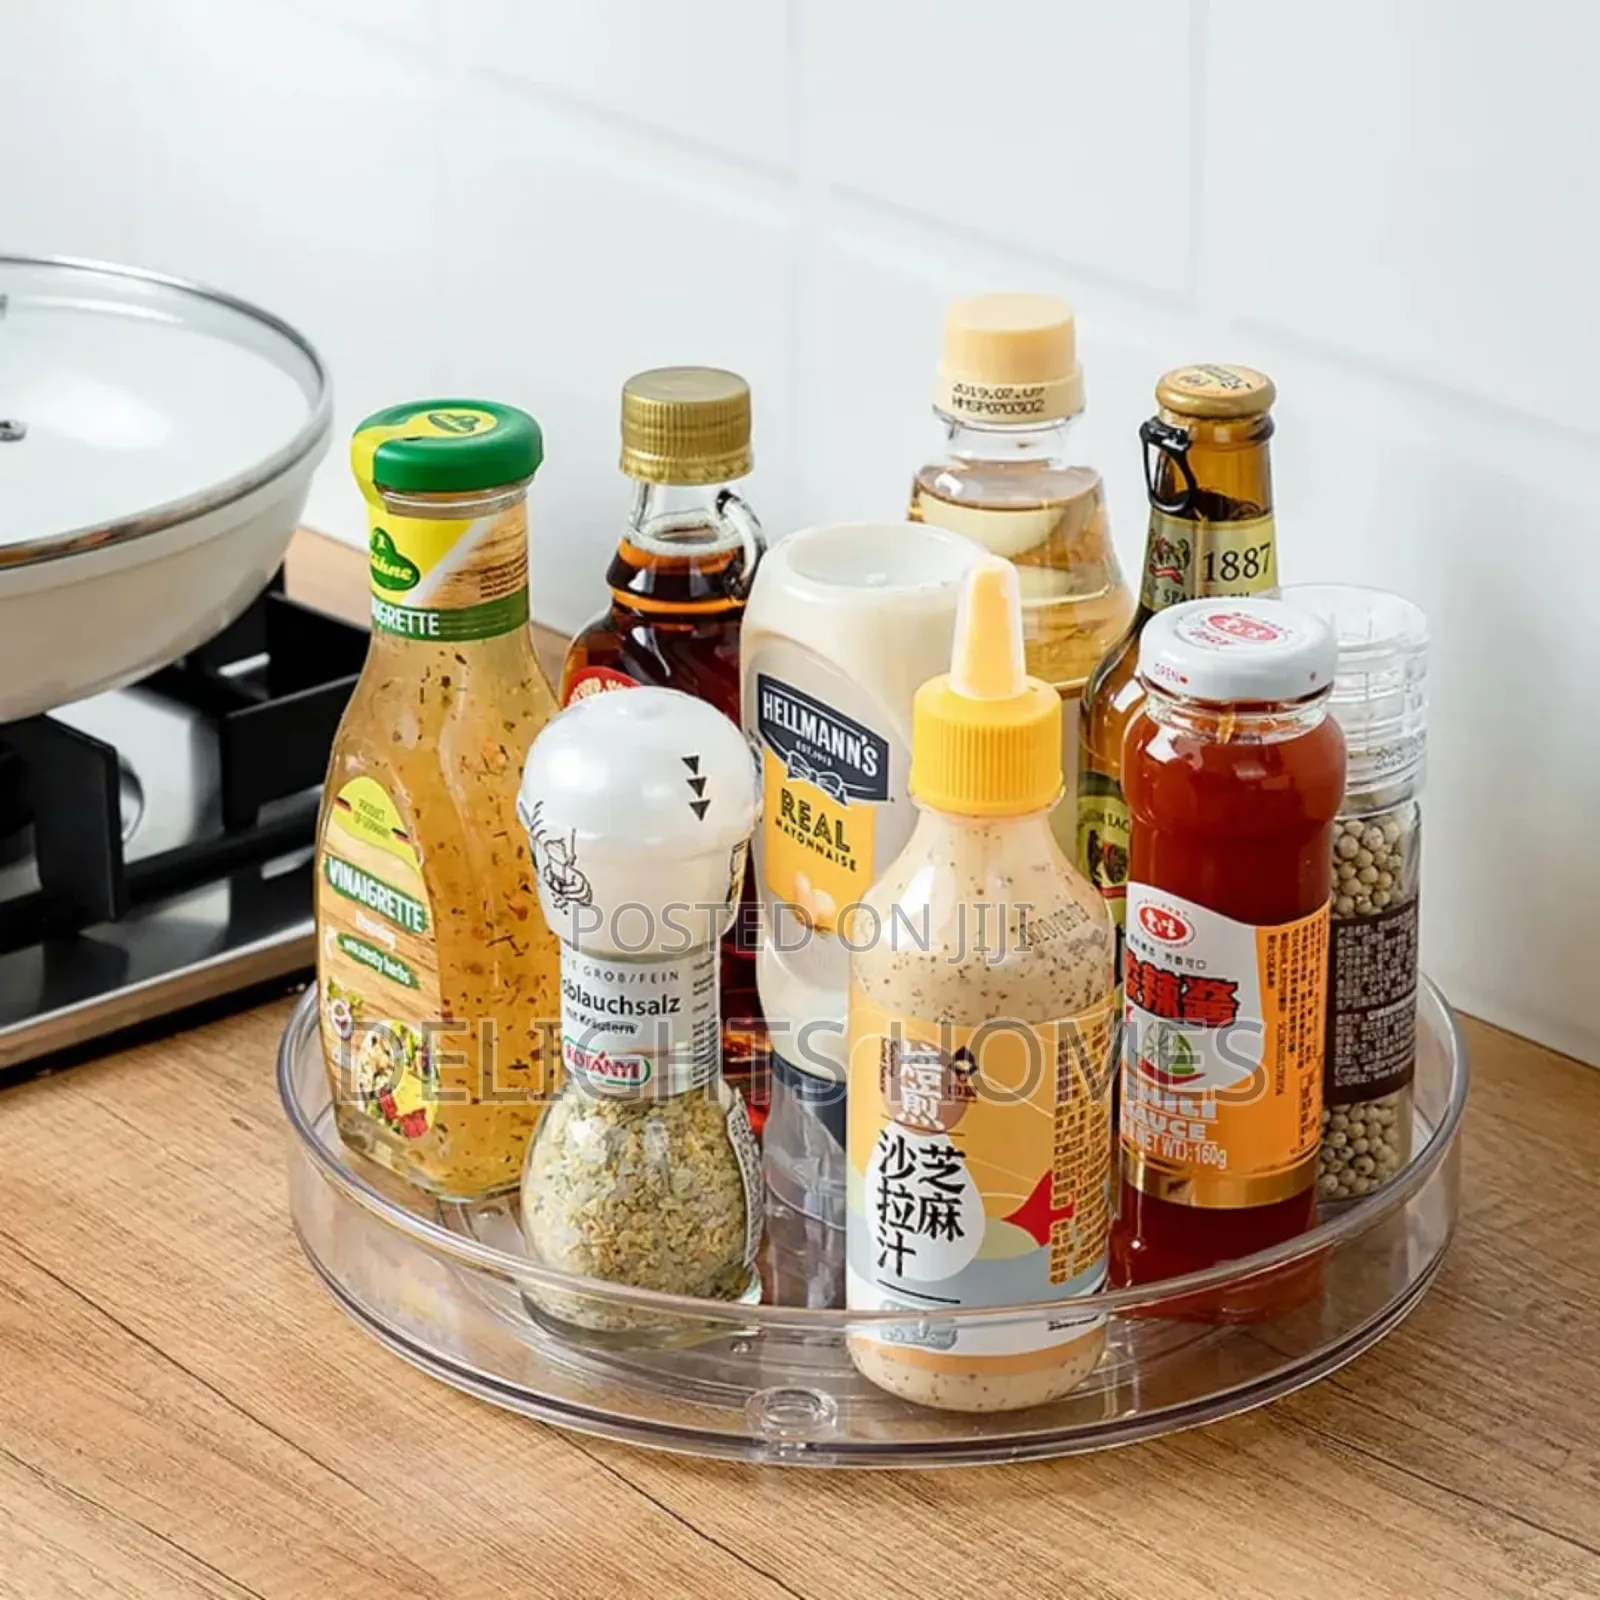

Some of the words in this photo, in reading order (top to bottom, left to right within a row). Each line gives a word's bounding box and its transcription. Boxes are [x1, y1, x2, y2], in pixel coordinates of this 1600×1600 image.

[1202, 541, 1272, 583] 1887
[762, 690, 878, 777] HELLMANN'S
[775, 818, 856, 872] MAYONNAISE
[781, 788, 851, 853] REAL
[328, 856, 425, 933] VINAIGRETTE
[877, 1129, 918, 1278] 沙拉汁
[916, 1143, 967, 1242] 芝麻
